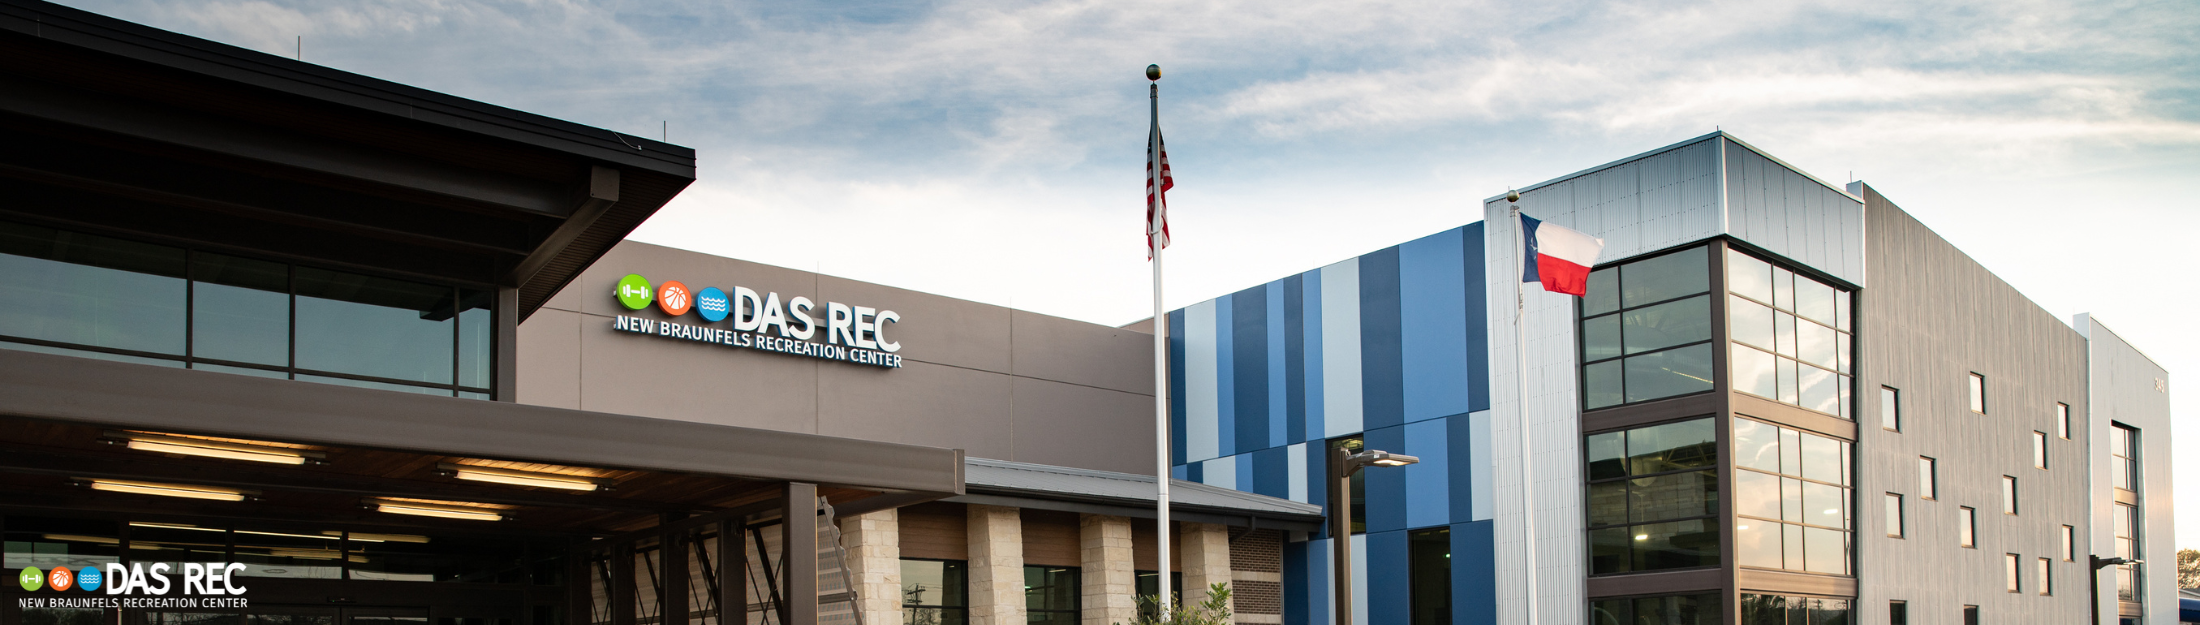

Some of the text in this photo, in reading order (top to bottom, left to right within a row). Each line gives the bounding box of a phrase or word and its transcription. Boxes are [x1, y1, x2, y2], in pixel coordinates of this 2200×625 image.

[616, 315, 902, 368] NEW BRAUNFELS RECREATION CENTER
[733, 285, 901, 352] DAS REC
